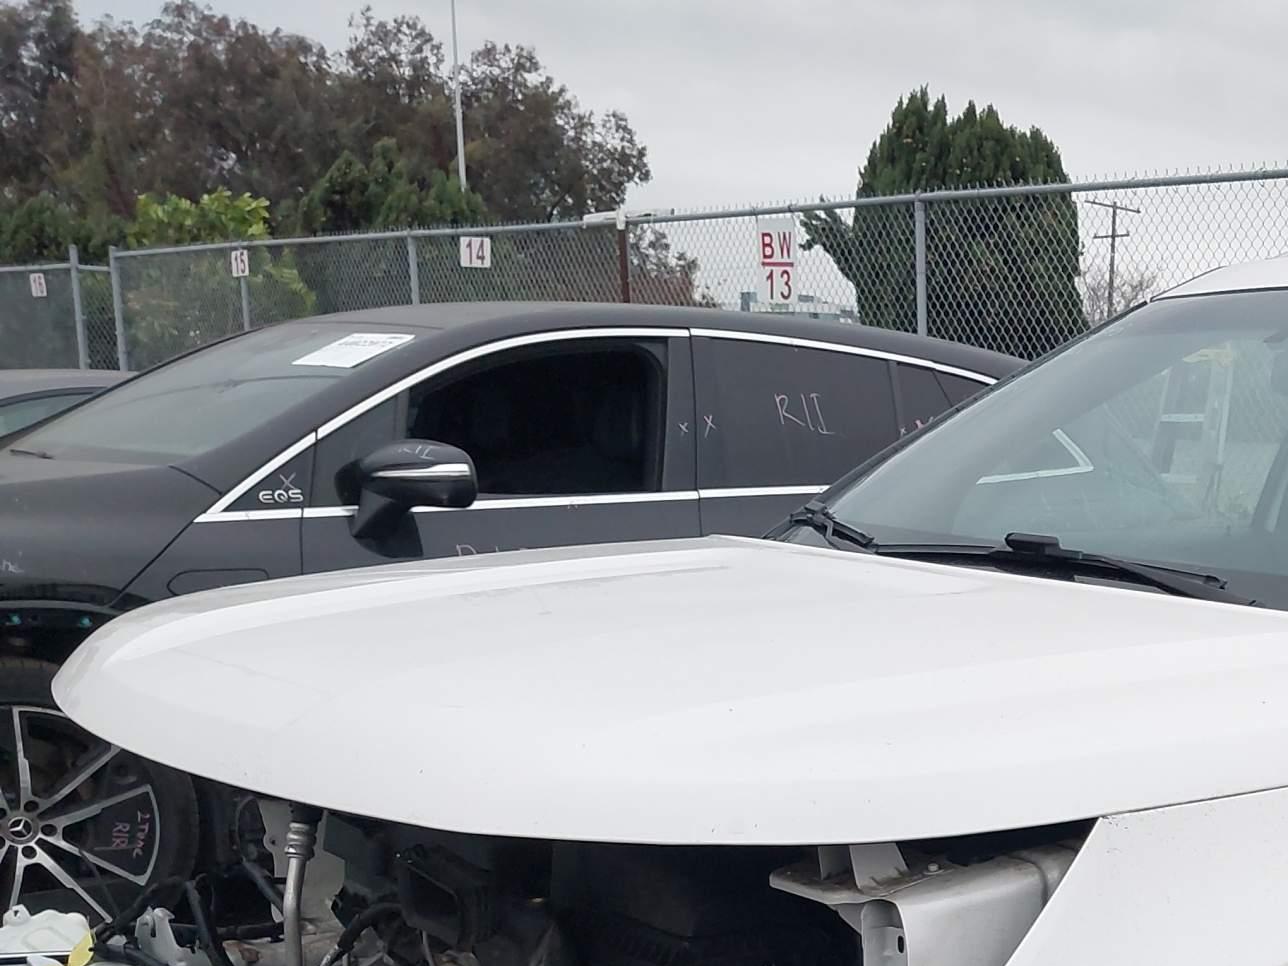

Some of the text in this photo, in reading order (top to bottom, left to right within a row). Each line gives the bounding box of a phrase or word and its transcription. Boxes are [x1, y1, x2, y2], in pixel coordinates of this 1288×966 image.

[465, 238, 486, 265] 14
[761, 231, 792, 259] BW
[234, 250, 246, 275] 15
[766, 268, 792, 300] 13
[258, 489, 304, 503] EQS
